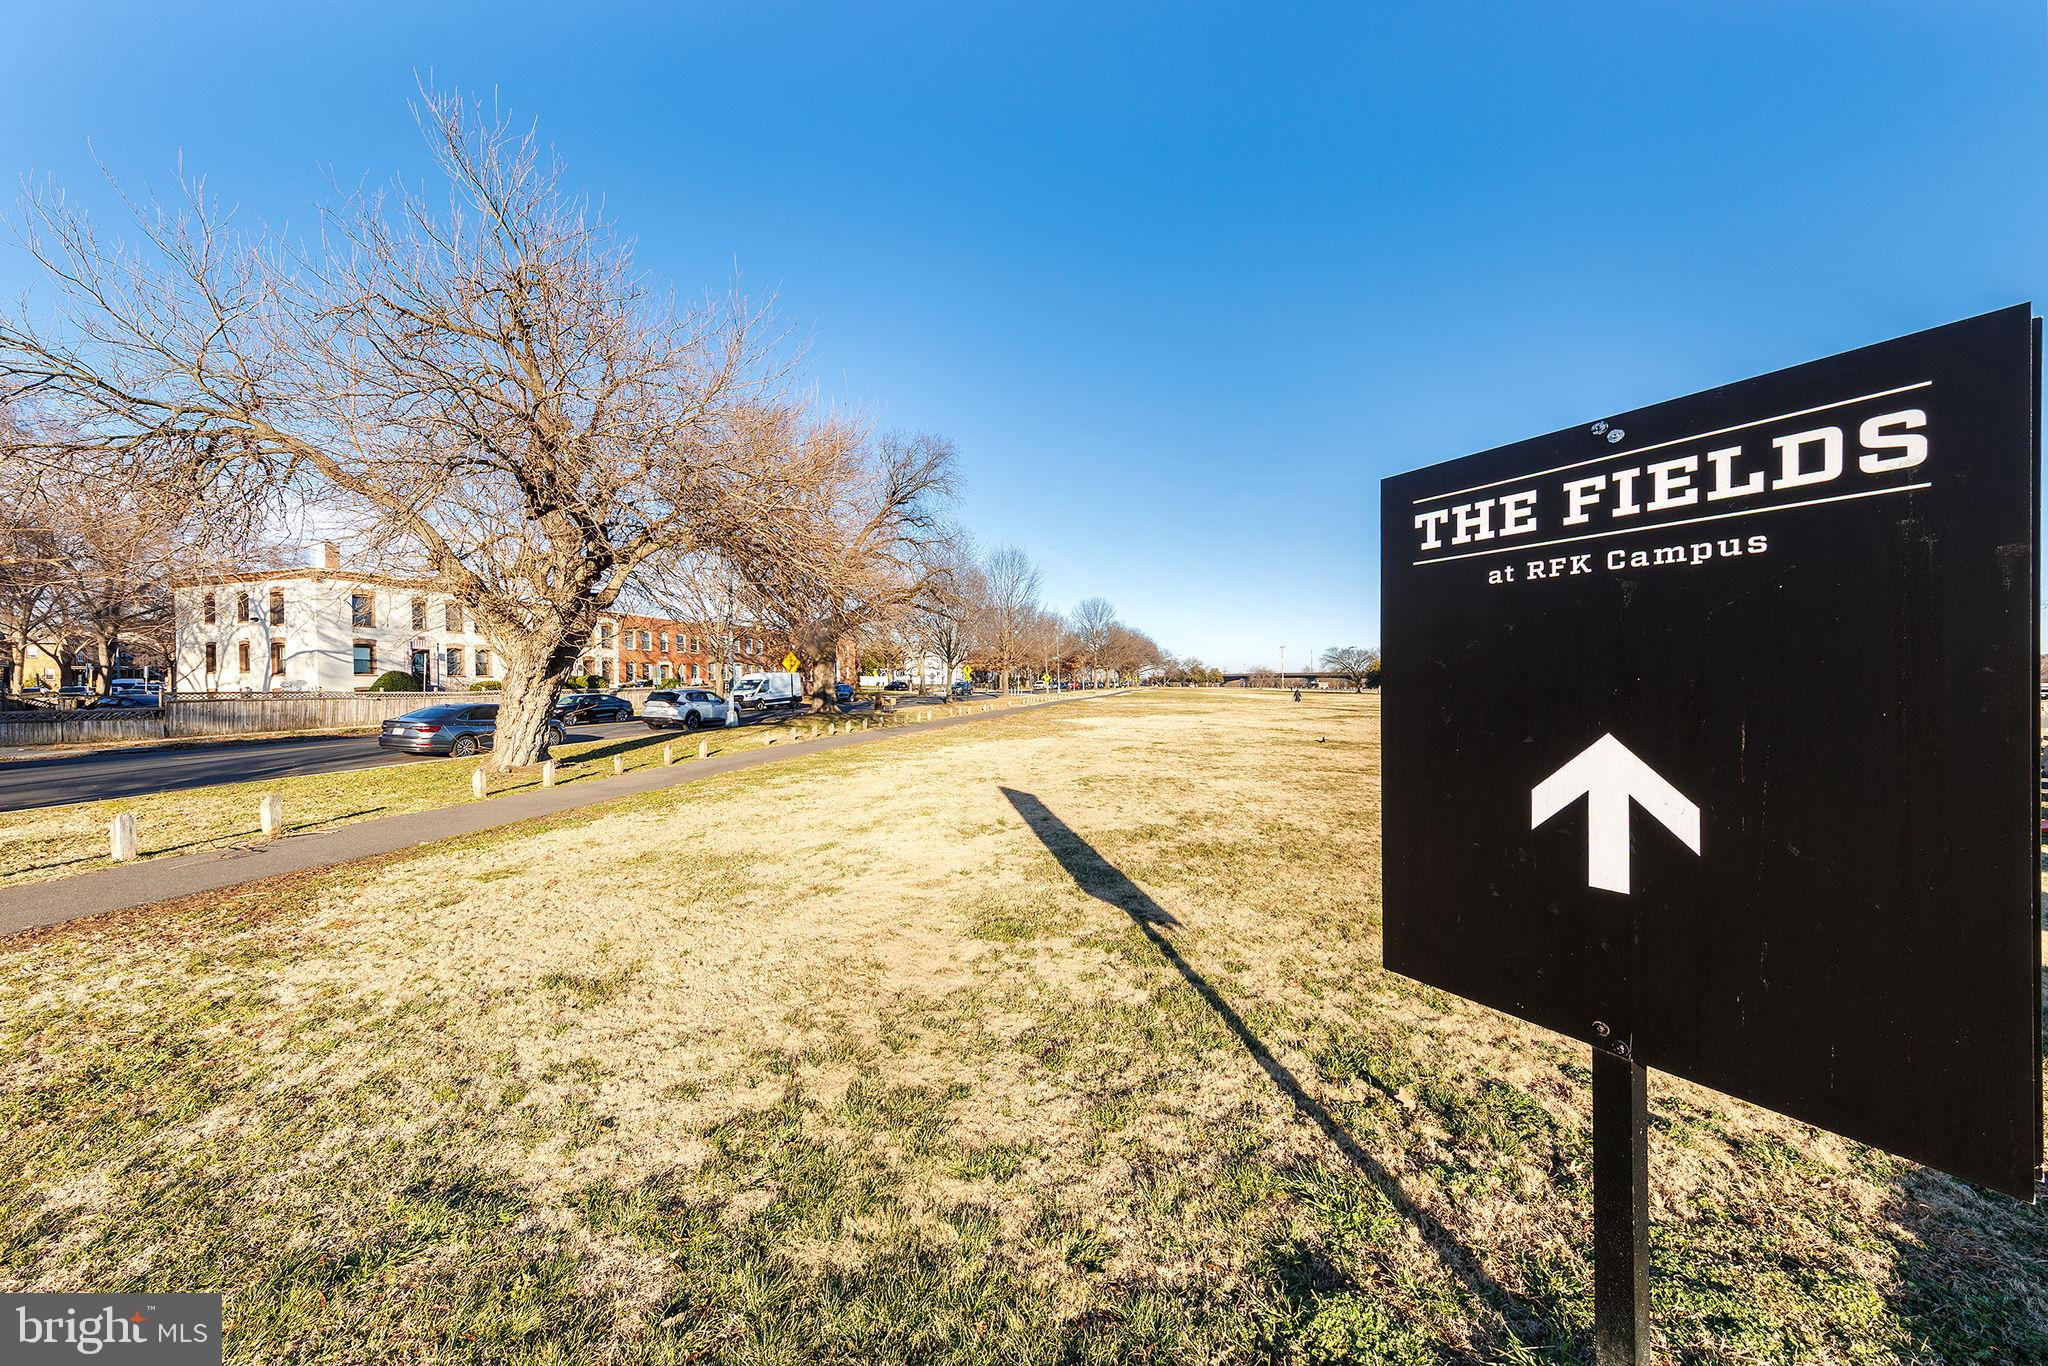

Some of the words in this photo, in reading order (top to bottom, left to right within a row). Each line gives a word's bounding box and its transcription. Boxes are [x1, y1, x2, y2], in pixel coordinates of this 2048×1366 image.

[1414, 489, 1537, 551] THE
[1562, 408, 1929, 527] FIELDS
[1488, 564, 1515, 585] at
[1527, 554, 1593, 581] RFK
[1607, 534, 1769, 571] Campus
